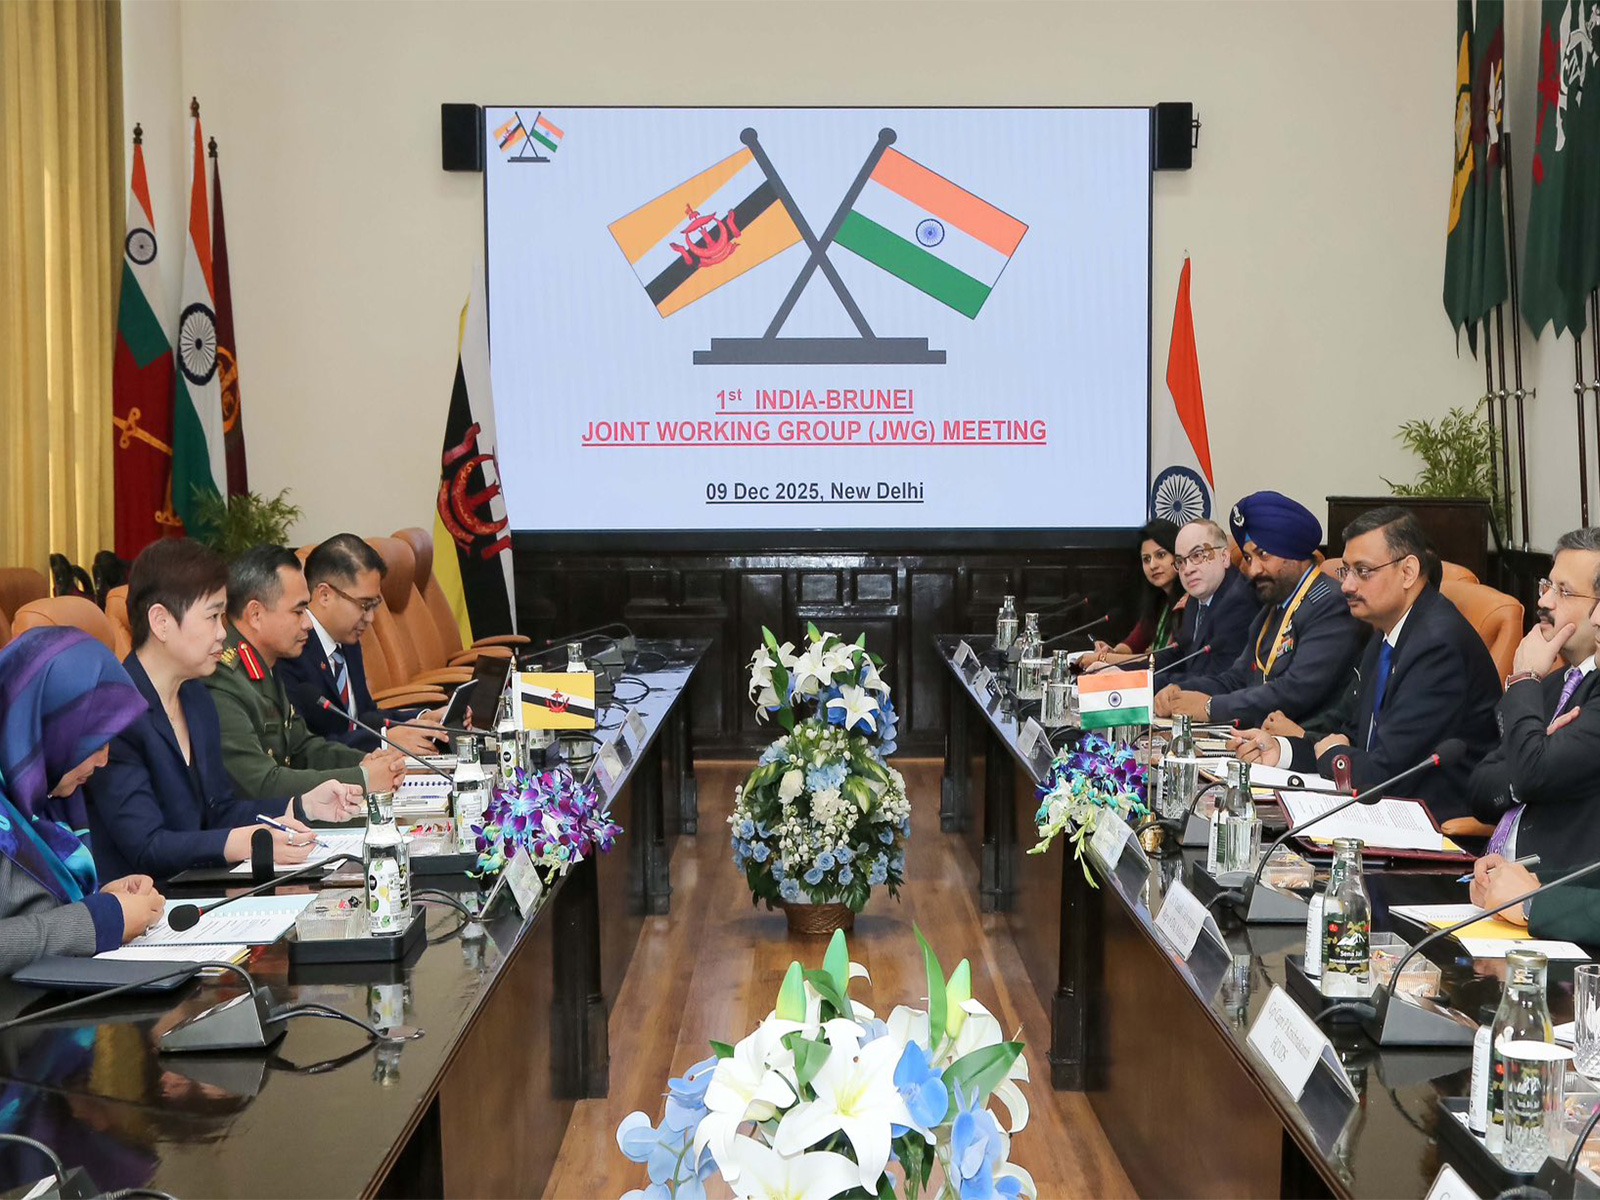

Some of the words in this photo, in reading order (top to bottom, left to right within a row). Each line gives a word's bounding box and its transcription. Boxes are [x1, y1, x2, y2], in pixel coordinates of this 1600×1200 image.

[716, 389, 743, 410] 1st
[755, 389, 914, 410] INDIA-BRUNEI
[581, 420, 651, 441] JOINT
[656, 420, 771, 441] WORKING
[777, 420, 862, 441] GROUP
[868, 420, 936, 443] (JWG)
[943, 419, 1047, 441] MEETING
[706, 482, 728, 499] 09
[734, 482, 770, 499] Dec
[775, 482, 824, 502] 2025,
[831, 482, 871, 499] New
[877, 481, 924, 499] Delhi
